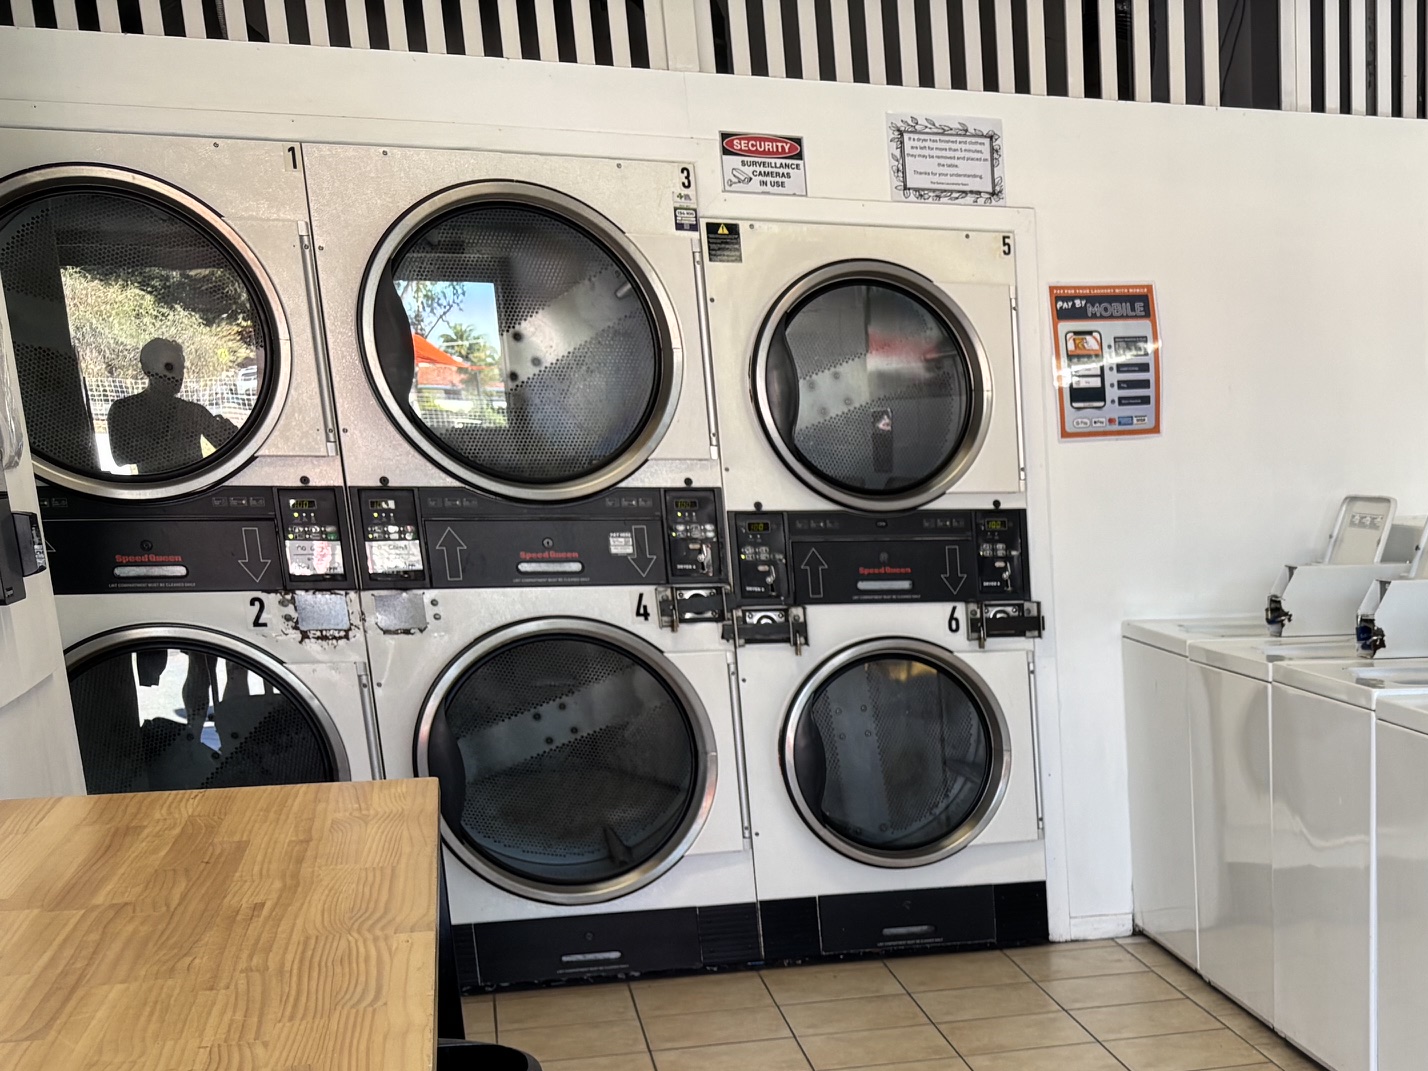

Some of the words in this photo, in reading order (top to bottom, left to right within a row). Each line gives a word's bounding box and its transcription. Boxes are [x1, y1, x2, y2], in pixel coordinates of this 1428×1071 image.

[733, 139, 791, 153] SECURITY
[287, 146, 297, 170] 1
[740, 160, 801, 171] SURVEILLANCE
[680, 167, 691, 189] 3
[752, 170, 792, 179] CAMERAS
[770, 180, 786, 188] USE
[1002, 235, 1012, 256] 5
[1056, 300, 1073, 310] PAY
[1086, 302, 1145, 317] MOBILE
[116, 554, 149, 563] Speed
[150, 554, 182, 562] Queen
[520, 551, 550, 559] Speed
[859, 566, 885, 575] Speed
[885, 566, 911, 574] Queen
[250, 596, 268, 628] 2
[635, 592, 650, 621] 4
[948, 605, 960, 633] 6
